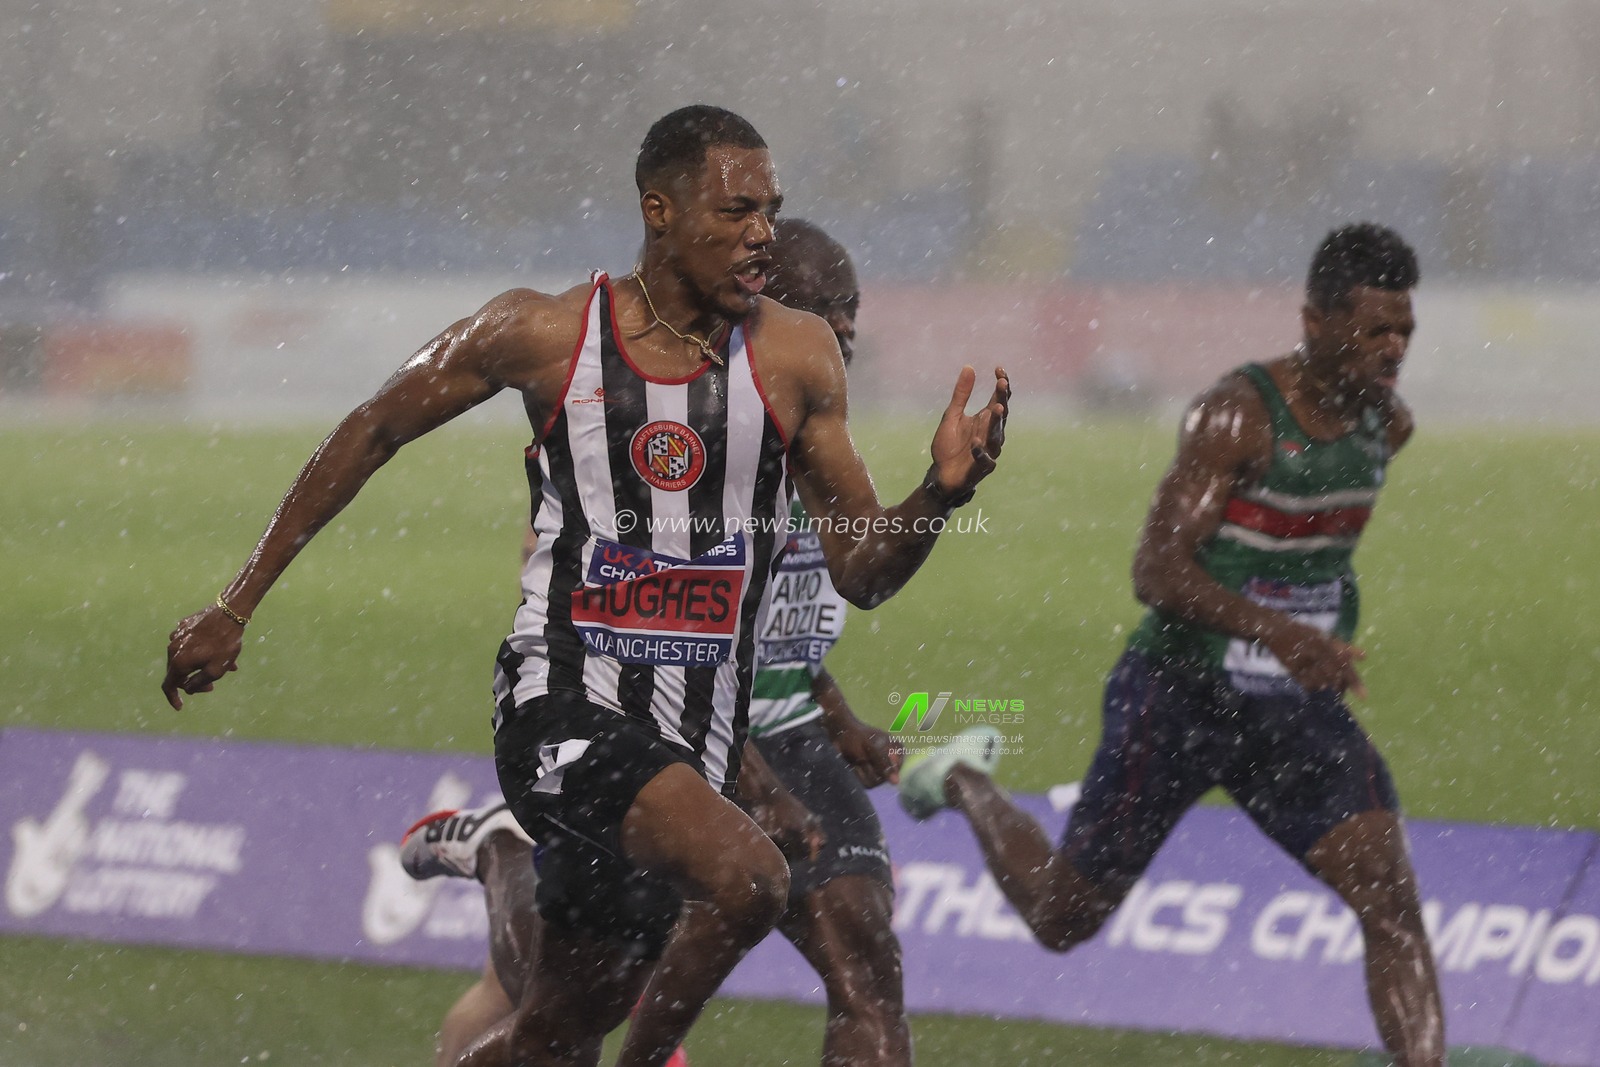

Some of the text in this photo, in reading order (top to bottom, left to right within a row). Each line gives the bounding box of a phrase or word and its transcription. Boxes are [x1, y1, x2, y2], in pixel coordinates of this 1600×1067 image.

[636, 424, 700, 455] SHAFTESBURY BARNET
[650, 475, 687, 489] HARRIERS
[582, 577, 732, 623] HUGHES
[584, 631, 720, 663] MANCHESTER
[1252, 889, 1600, 985] CHMPIO
